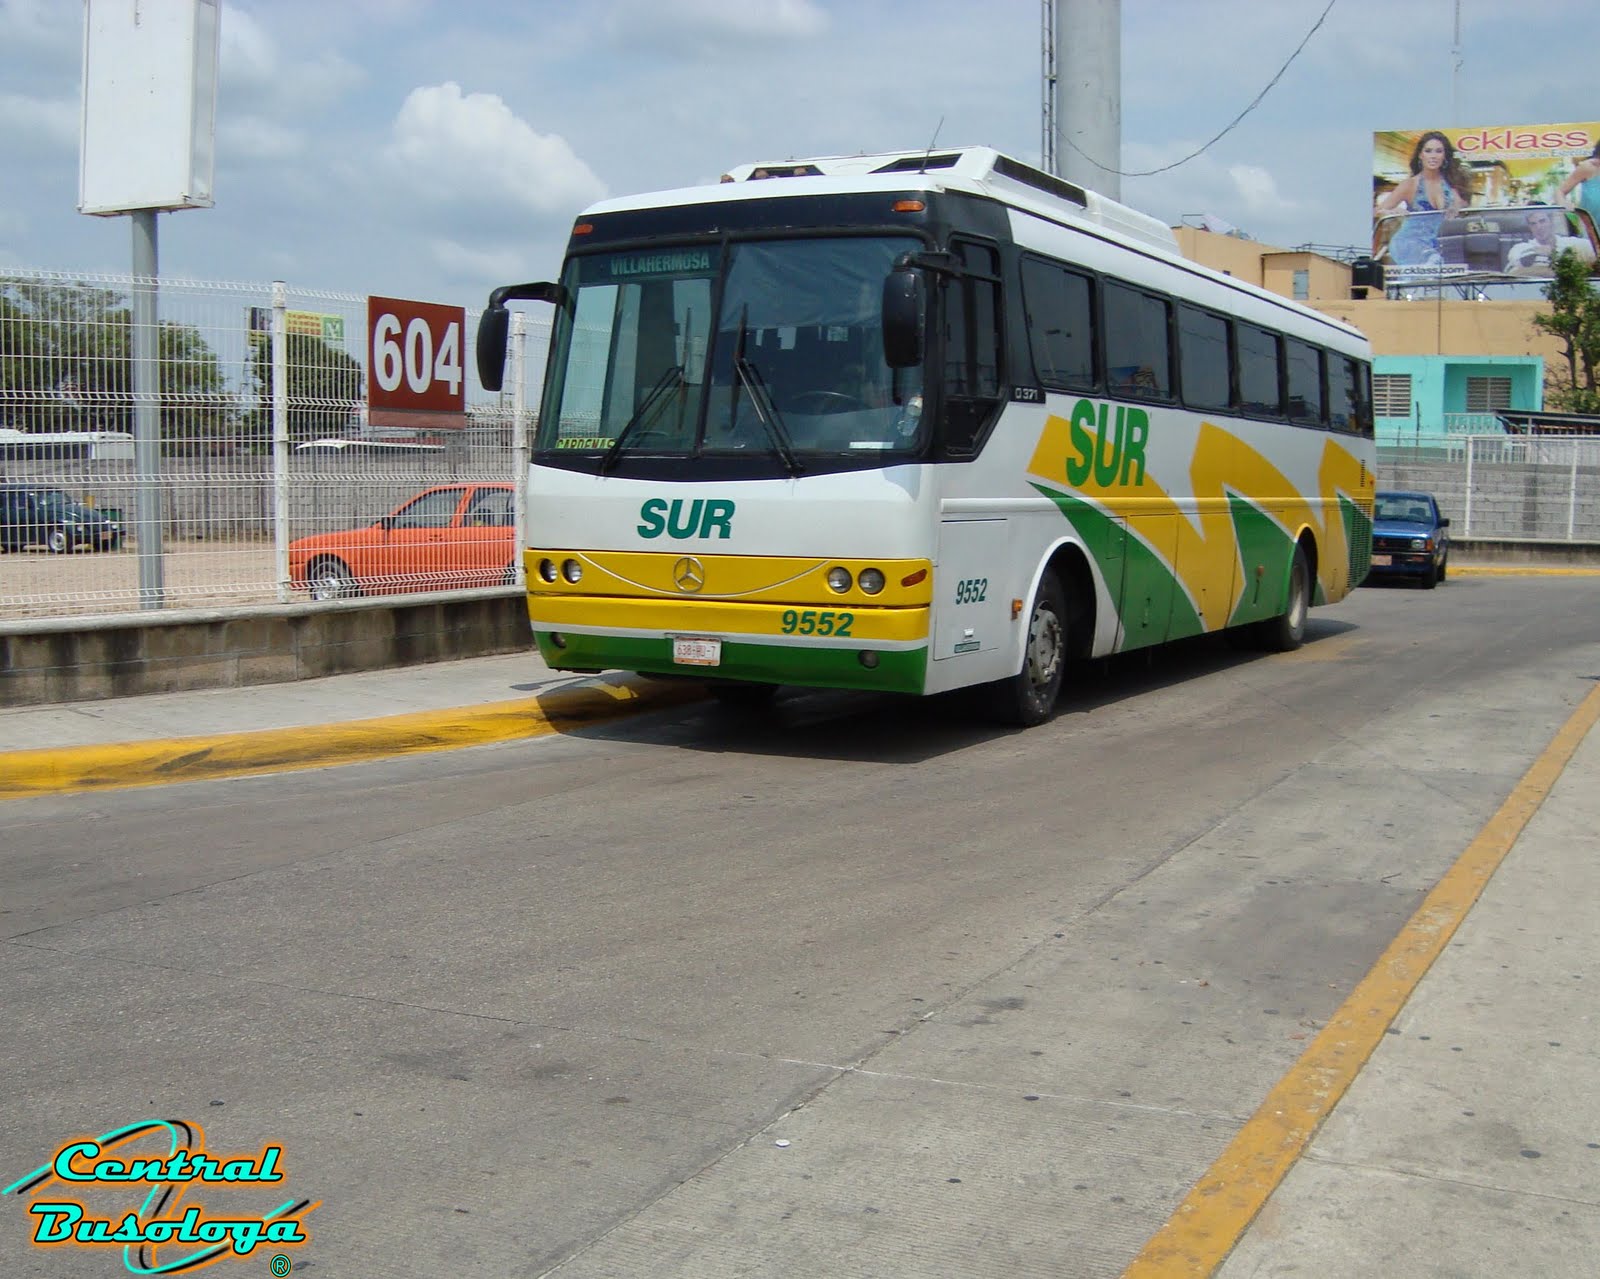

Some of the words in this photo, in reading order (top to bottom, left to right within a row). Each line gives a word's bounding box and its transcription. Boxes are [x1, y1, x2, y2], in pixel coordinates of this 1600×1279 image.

[1457, 130, 1589, 152] cklass
[610, 252, 710, 276] VILLAHERMOSA
[373, 312, 463, 396] 604
[1066, 398, 1149, 488] SUR
[637, 498, 736, 540] SUR
[955, 578, 988, 605] 9552
[781, 609, 855, 637] 9552
